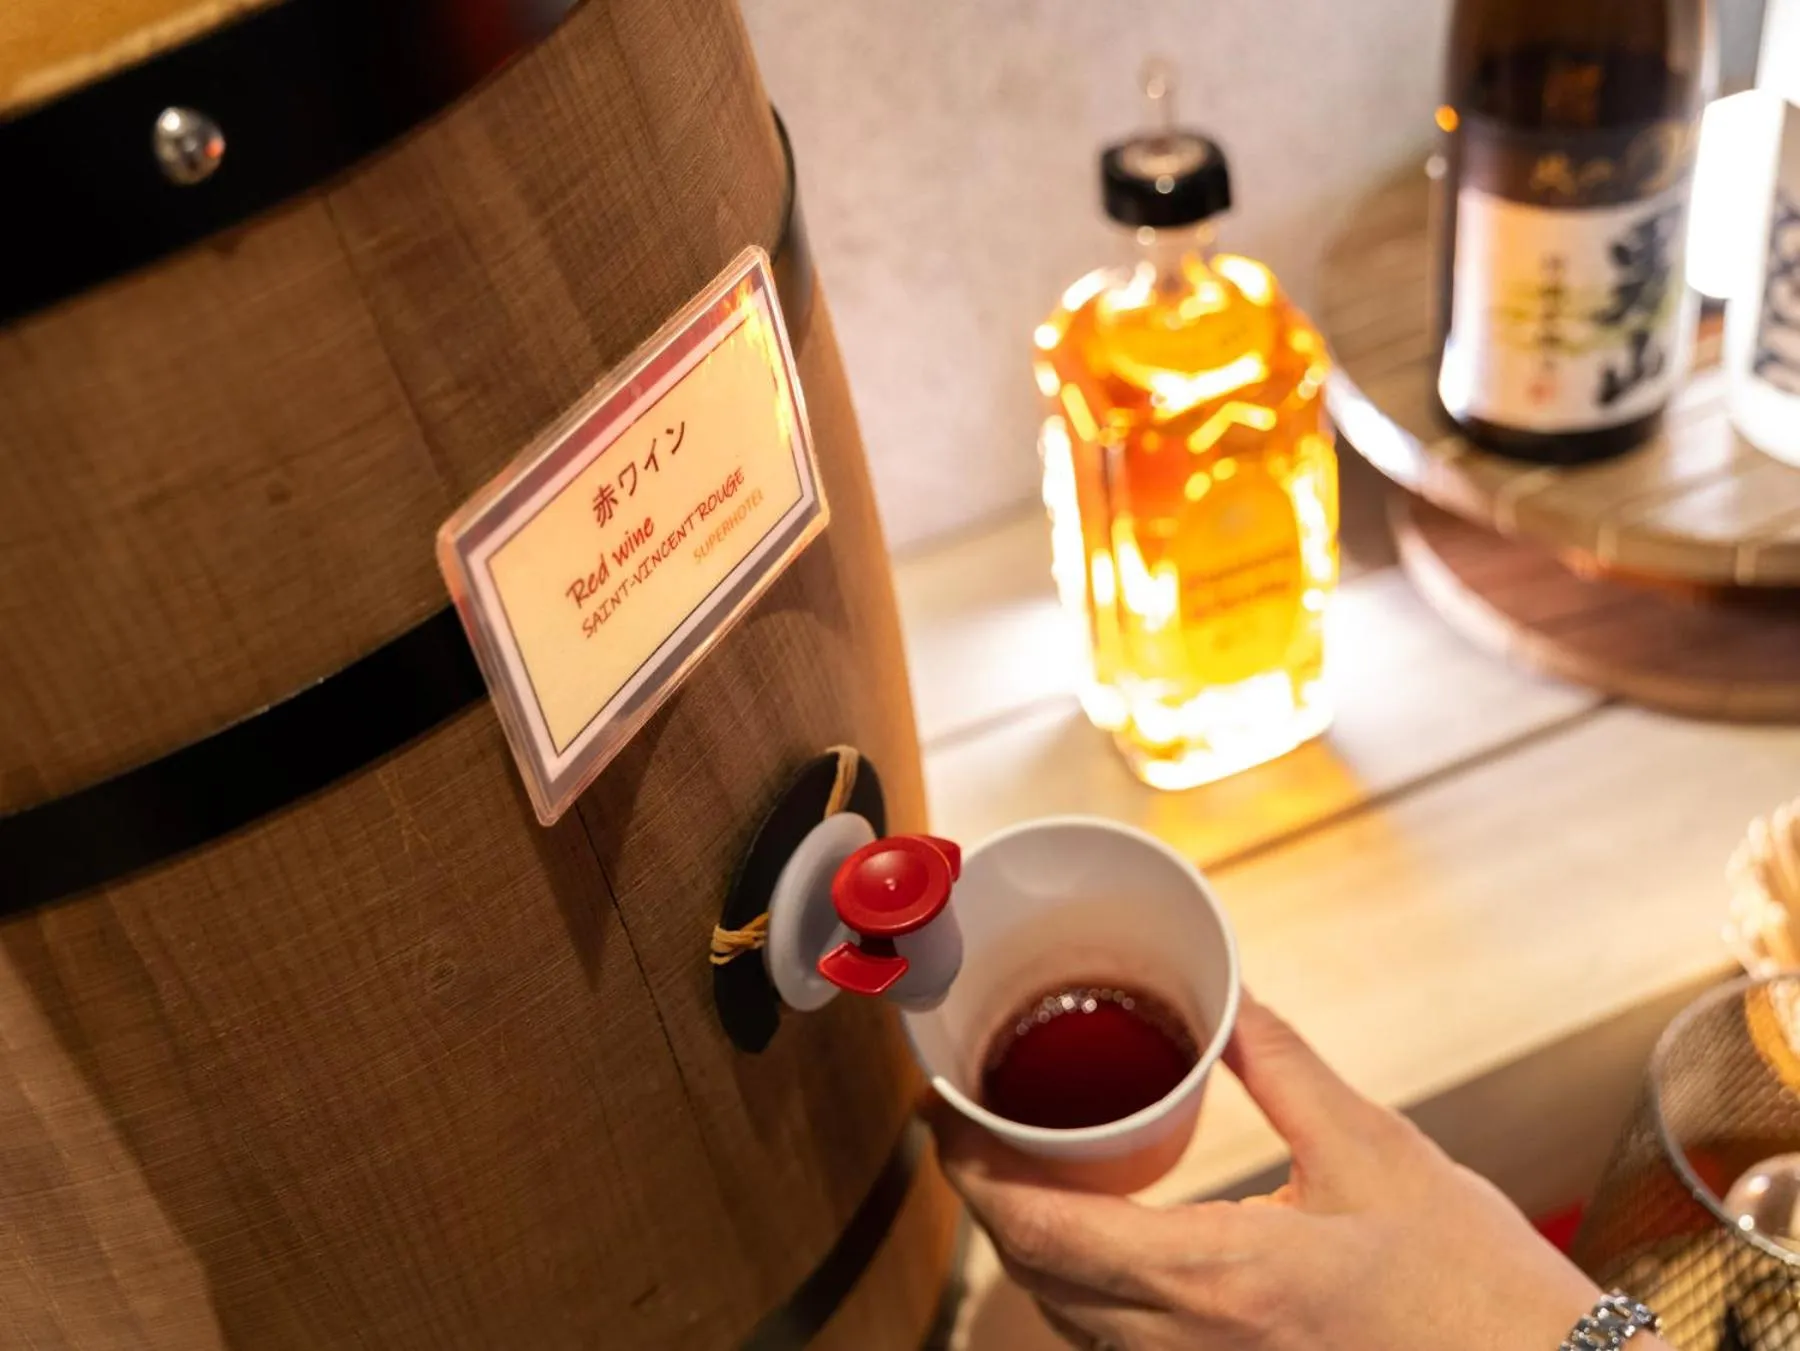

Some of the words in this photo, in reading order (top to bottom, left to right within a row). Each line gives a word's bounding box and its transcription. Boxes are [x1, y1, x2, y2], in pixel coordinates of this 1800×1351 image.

[592, 420, 685, 528] 赤ワイン
[565, 552, 610, 609] Red
[612, 516, 654, 567] wine
[582, 511, 694, 639] SAINT-VINCENT
[694, 466, 745, 521] ROUGE
